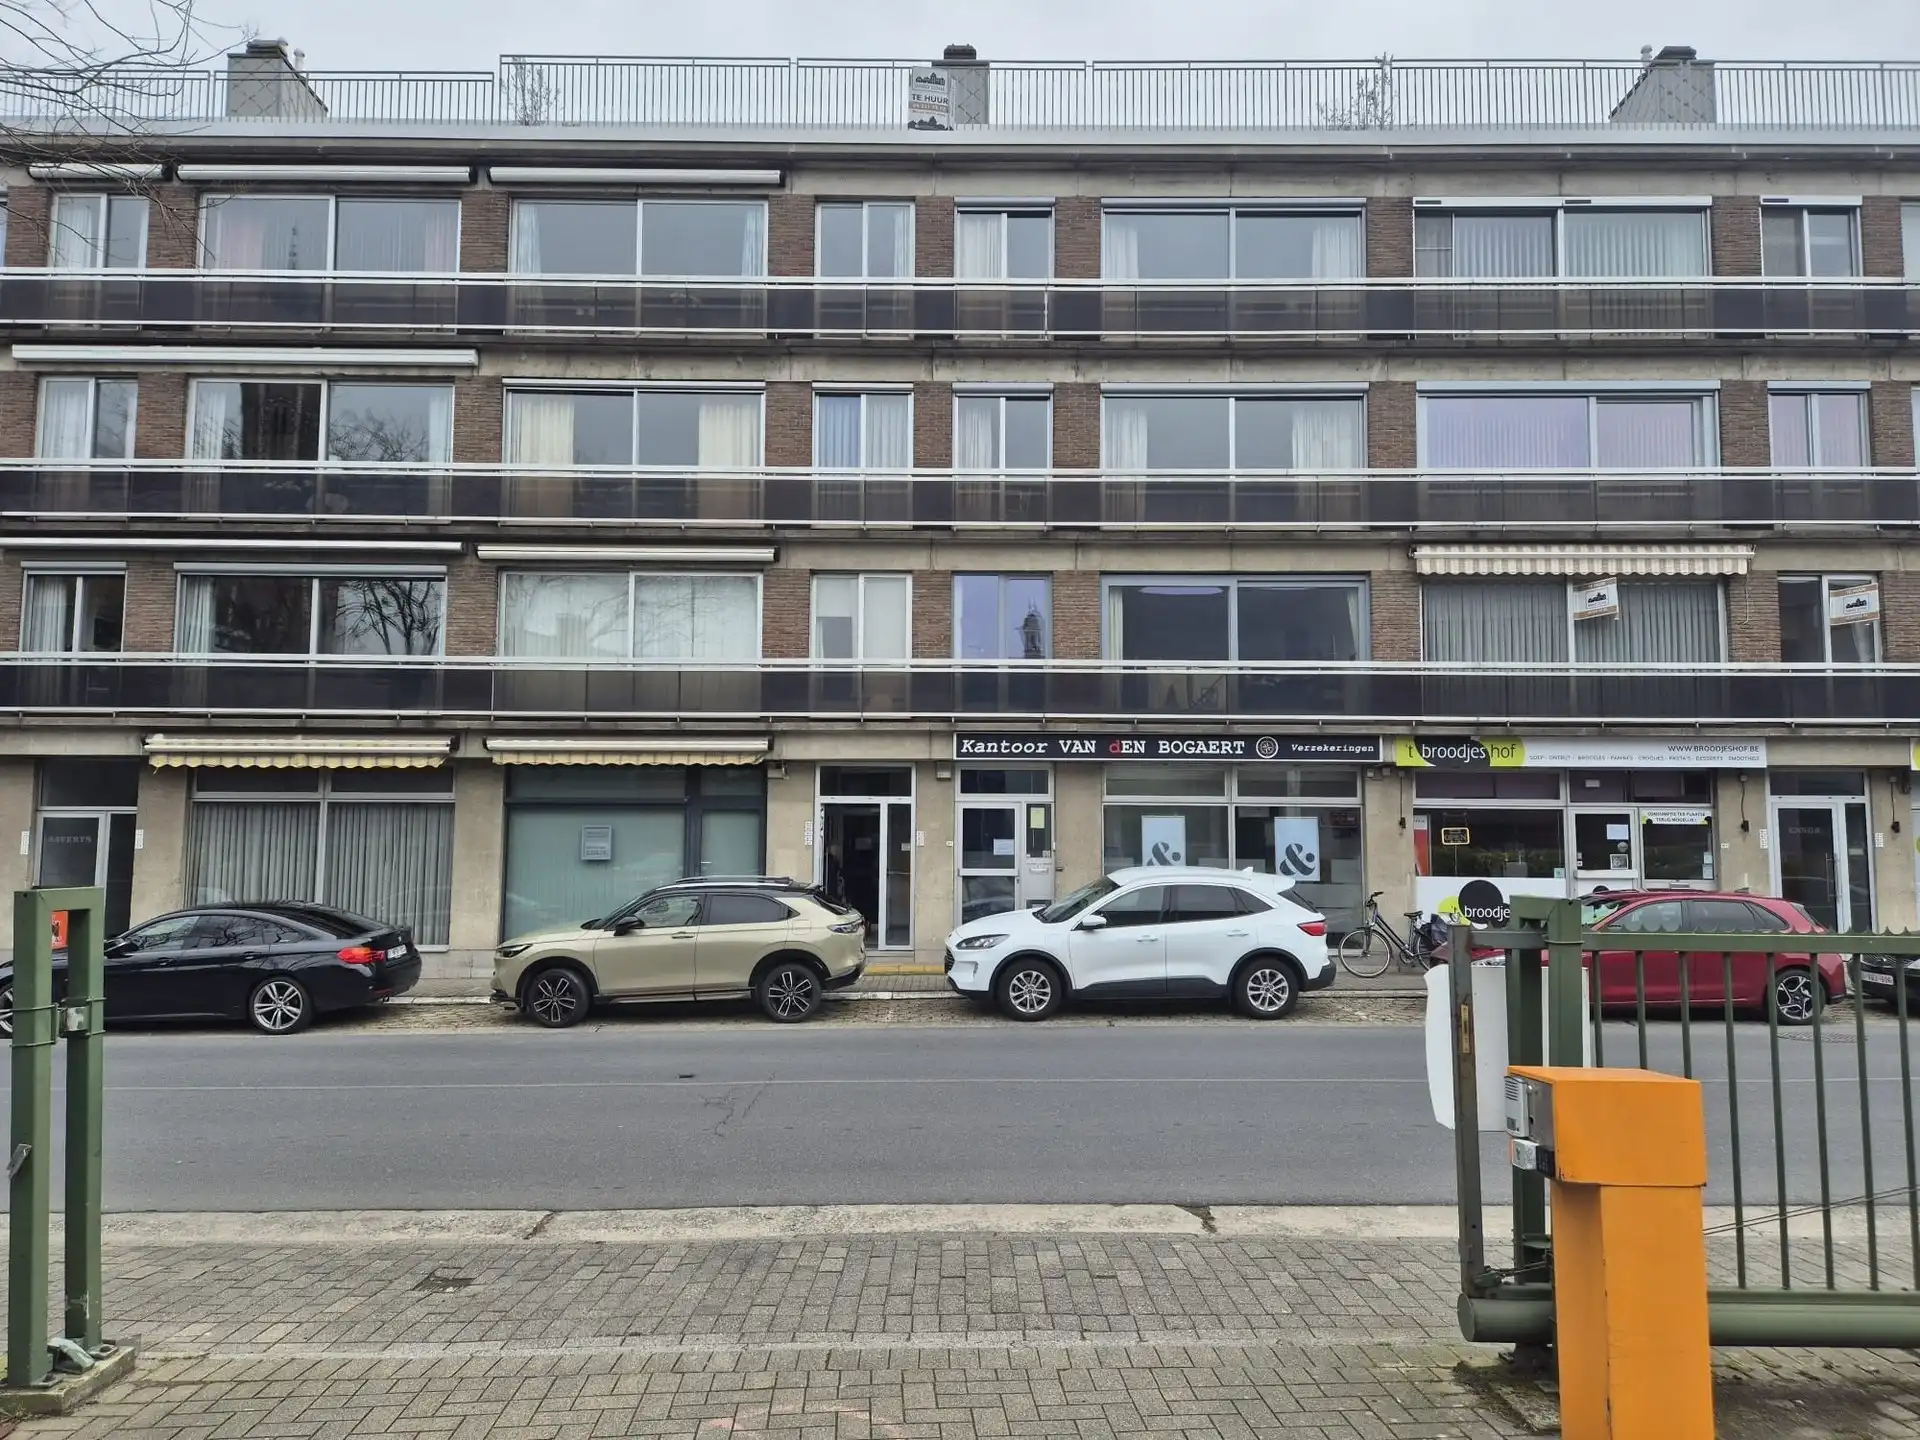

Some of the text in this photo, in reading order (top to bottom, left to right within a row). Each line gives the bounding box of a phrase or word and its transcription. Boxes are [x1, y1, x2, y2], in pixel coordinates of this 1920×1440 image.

[912, 93, 949, 105] TE HUUR
[961, 739, 1374, 755] Kantoor VAN dEN BOGAERT Verzekeringen
[1405, 743, 1517, 763] 't broodjes hof
[1464, 905, 1510, 922] broodje
